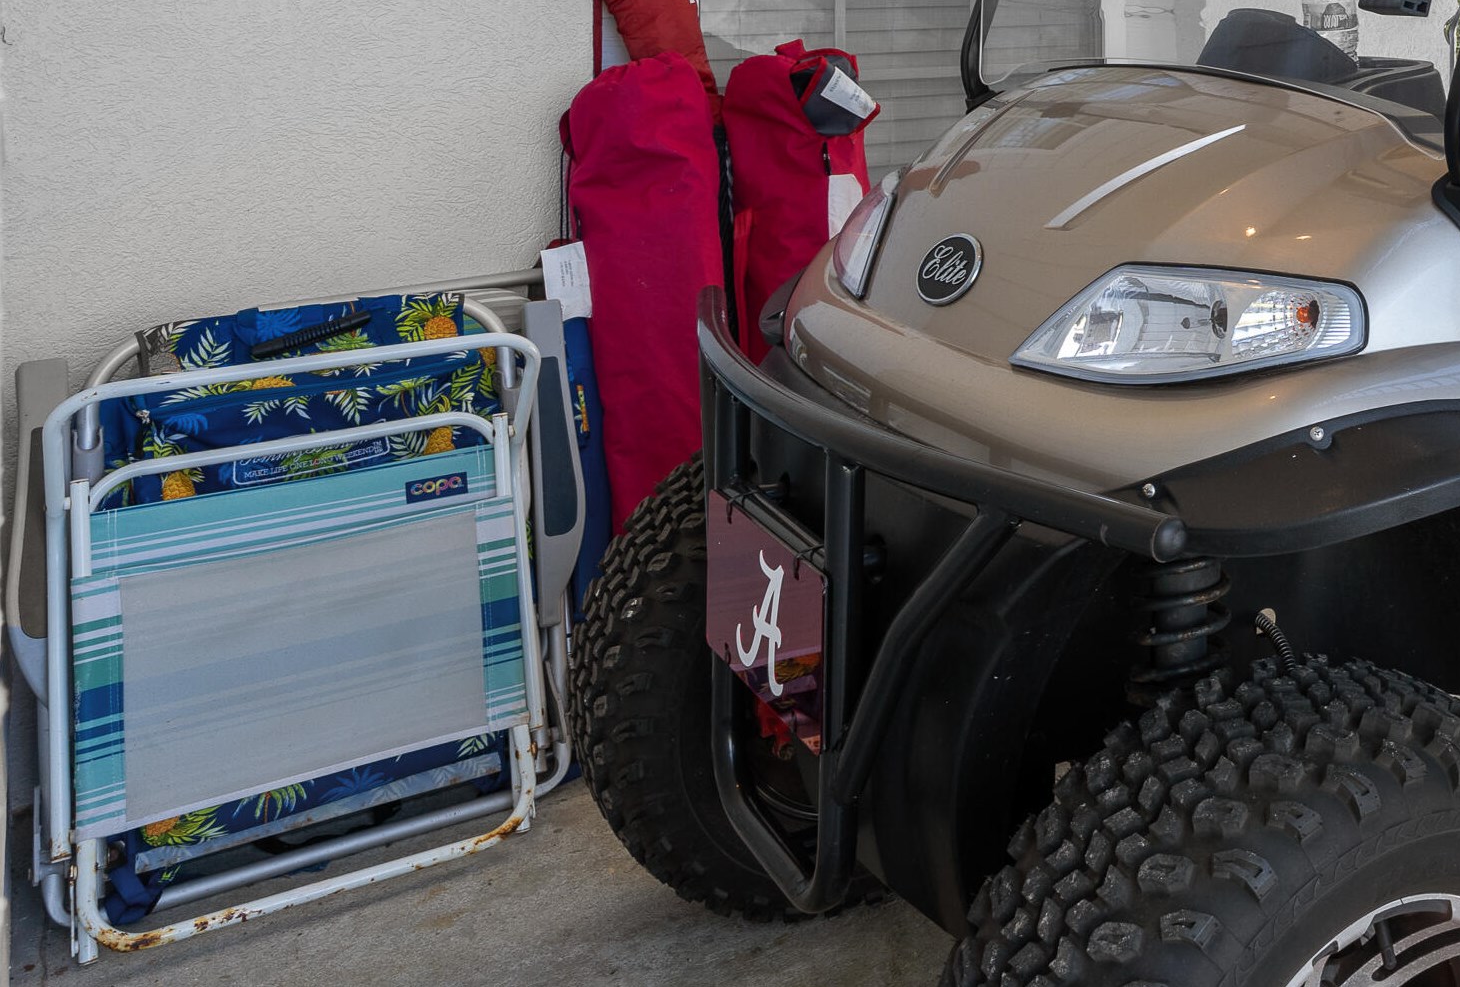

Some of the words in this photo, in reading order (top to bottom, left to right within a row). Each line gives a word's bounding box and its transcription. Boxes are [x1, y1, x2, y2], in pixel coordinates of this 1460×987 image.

[922, 245, 967, 285] Elite
[244, 468, 269, 479] MAKE
[270, 465, 289, 474] LIFE
[290, 461, 309, 471] ONE
[410, 476, 462, 496] copa
[736, 550, 784, 697] A
